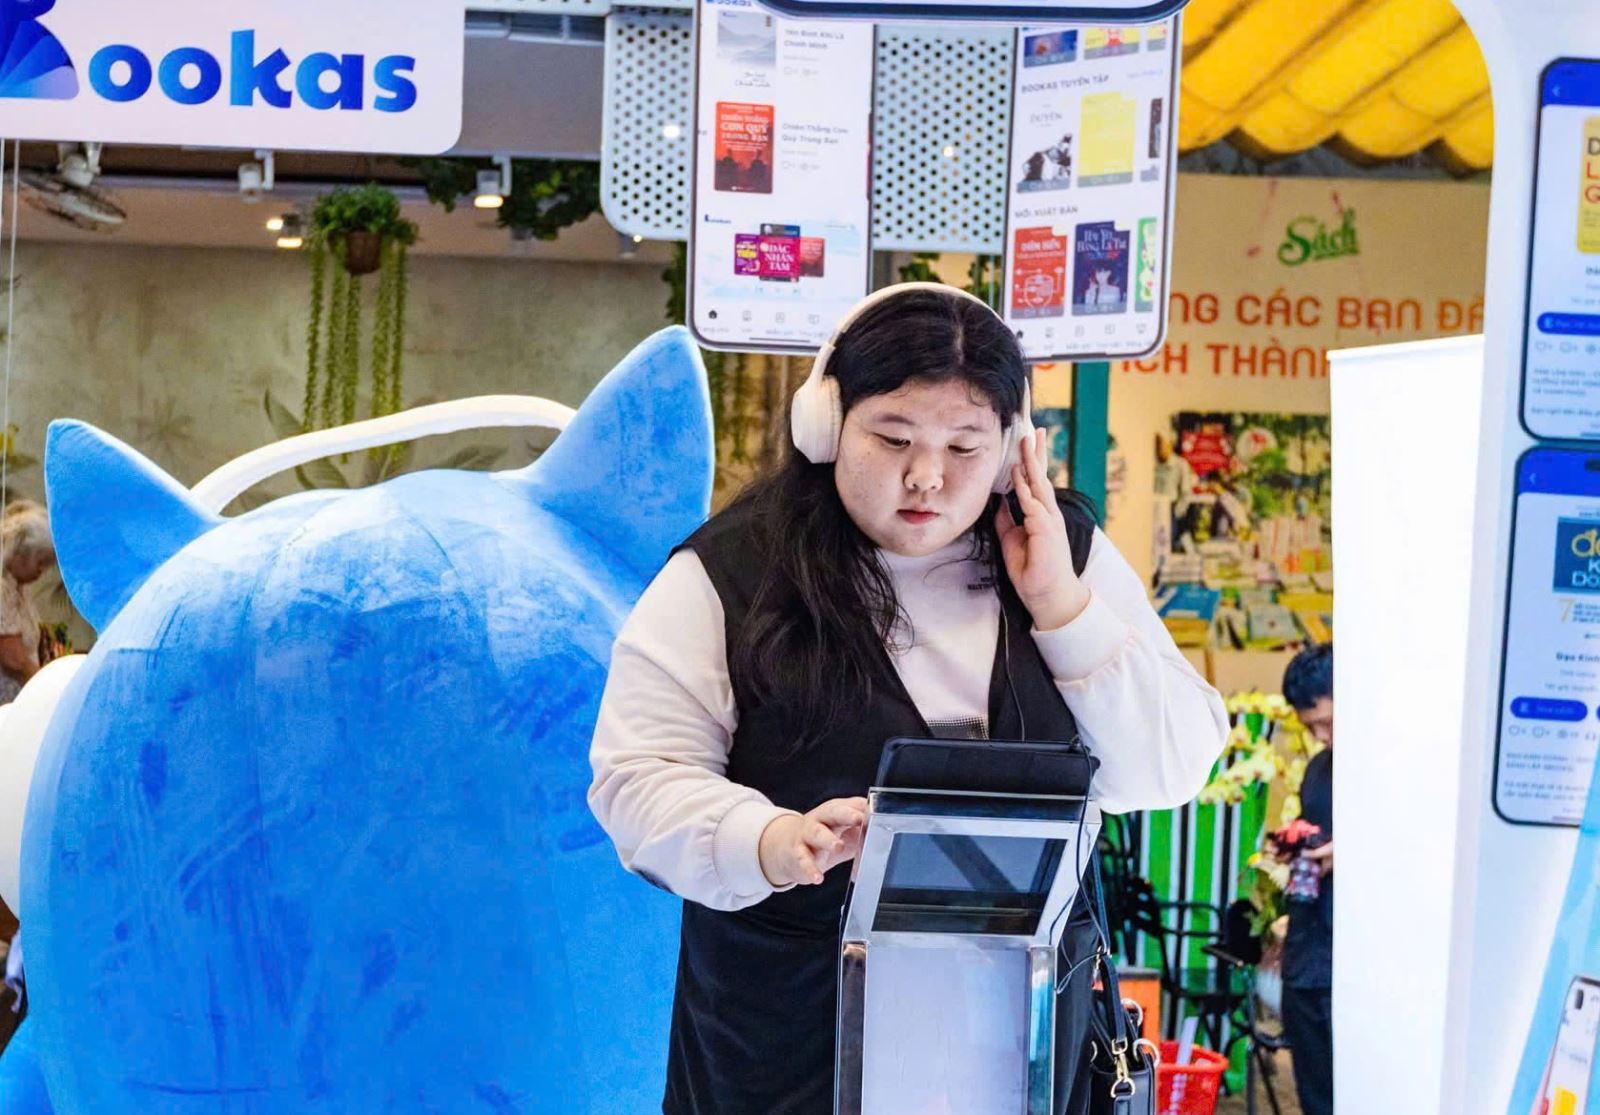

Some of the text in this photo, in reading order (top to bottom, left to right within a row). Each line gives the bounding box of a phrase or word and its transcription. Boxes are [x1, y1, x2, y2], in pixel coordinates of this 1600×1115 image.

[1021, 80, 1058, 93] BOOKAS
[1236, 285, 1322, 327] CÁC
[1337, 296, 1421, 336] BẠN
